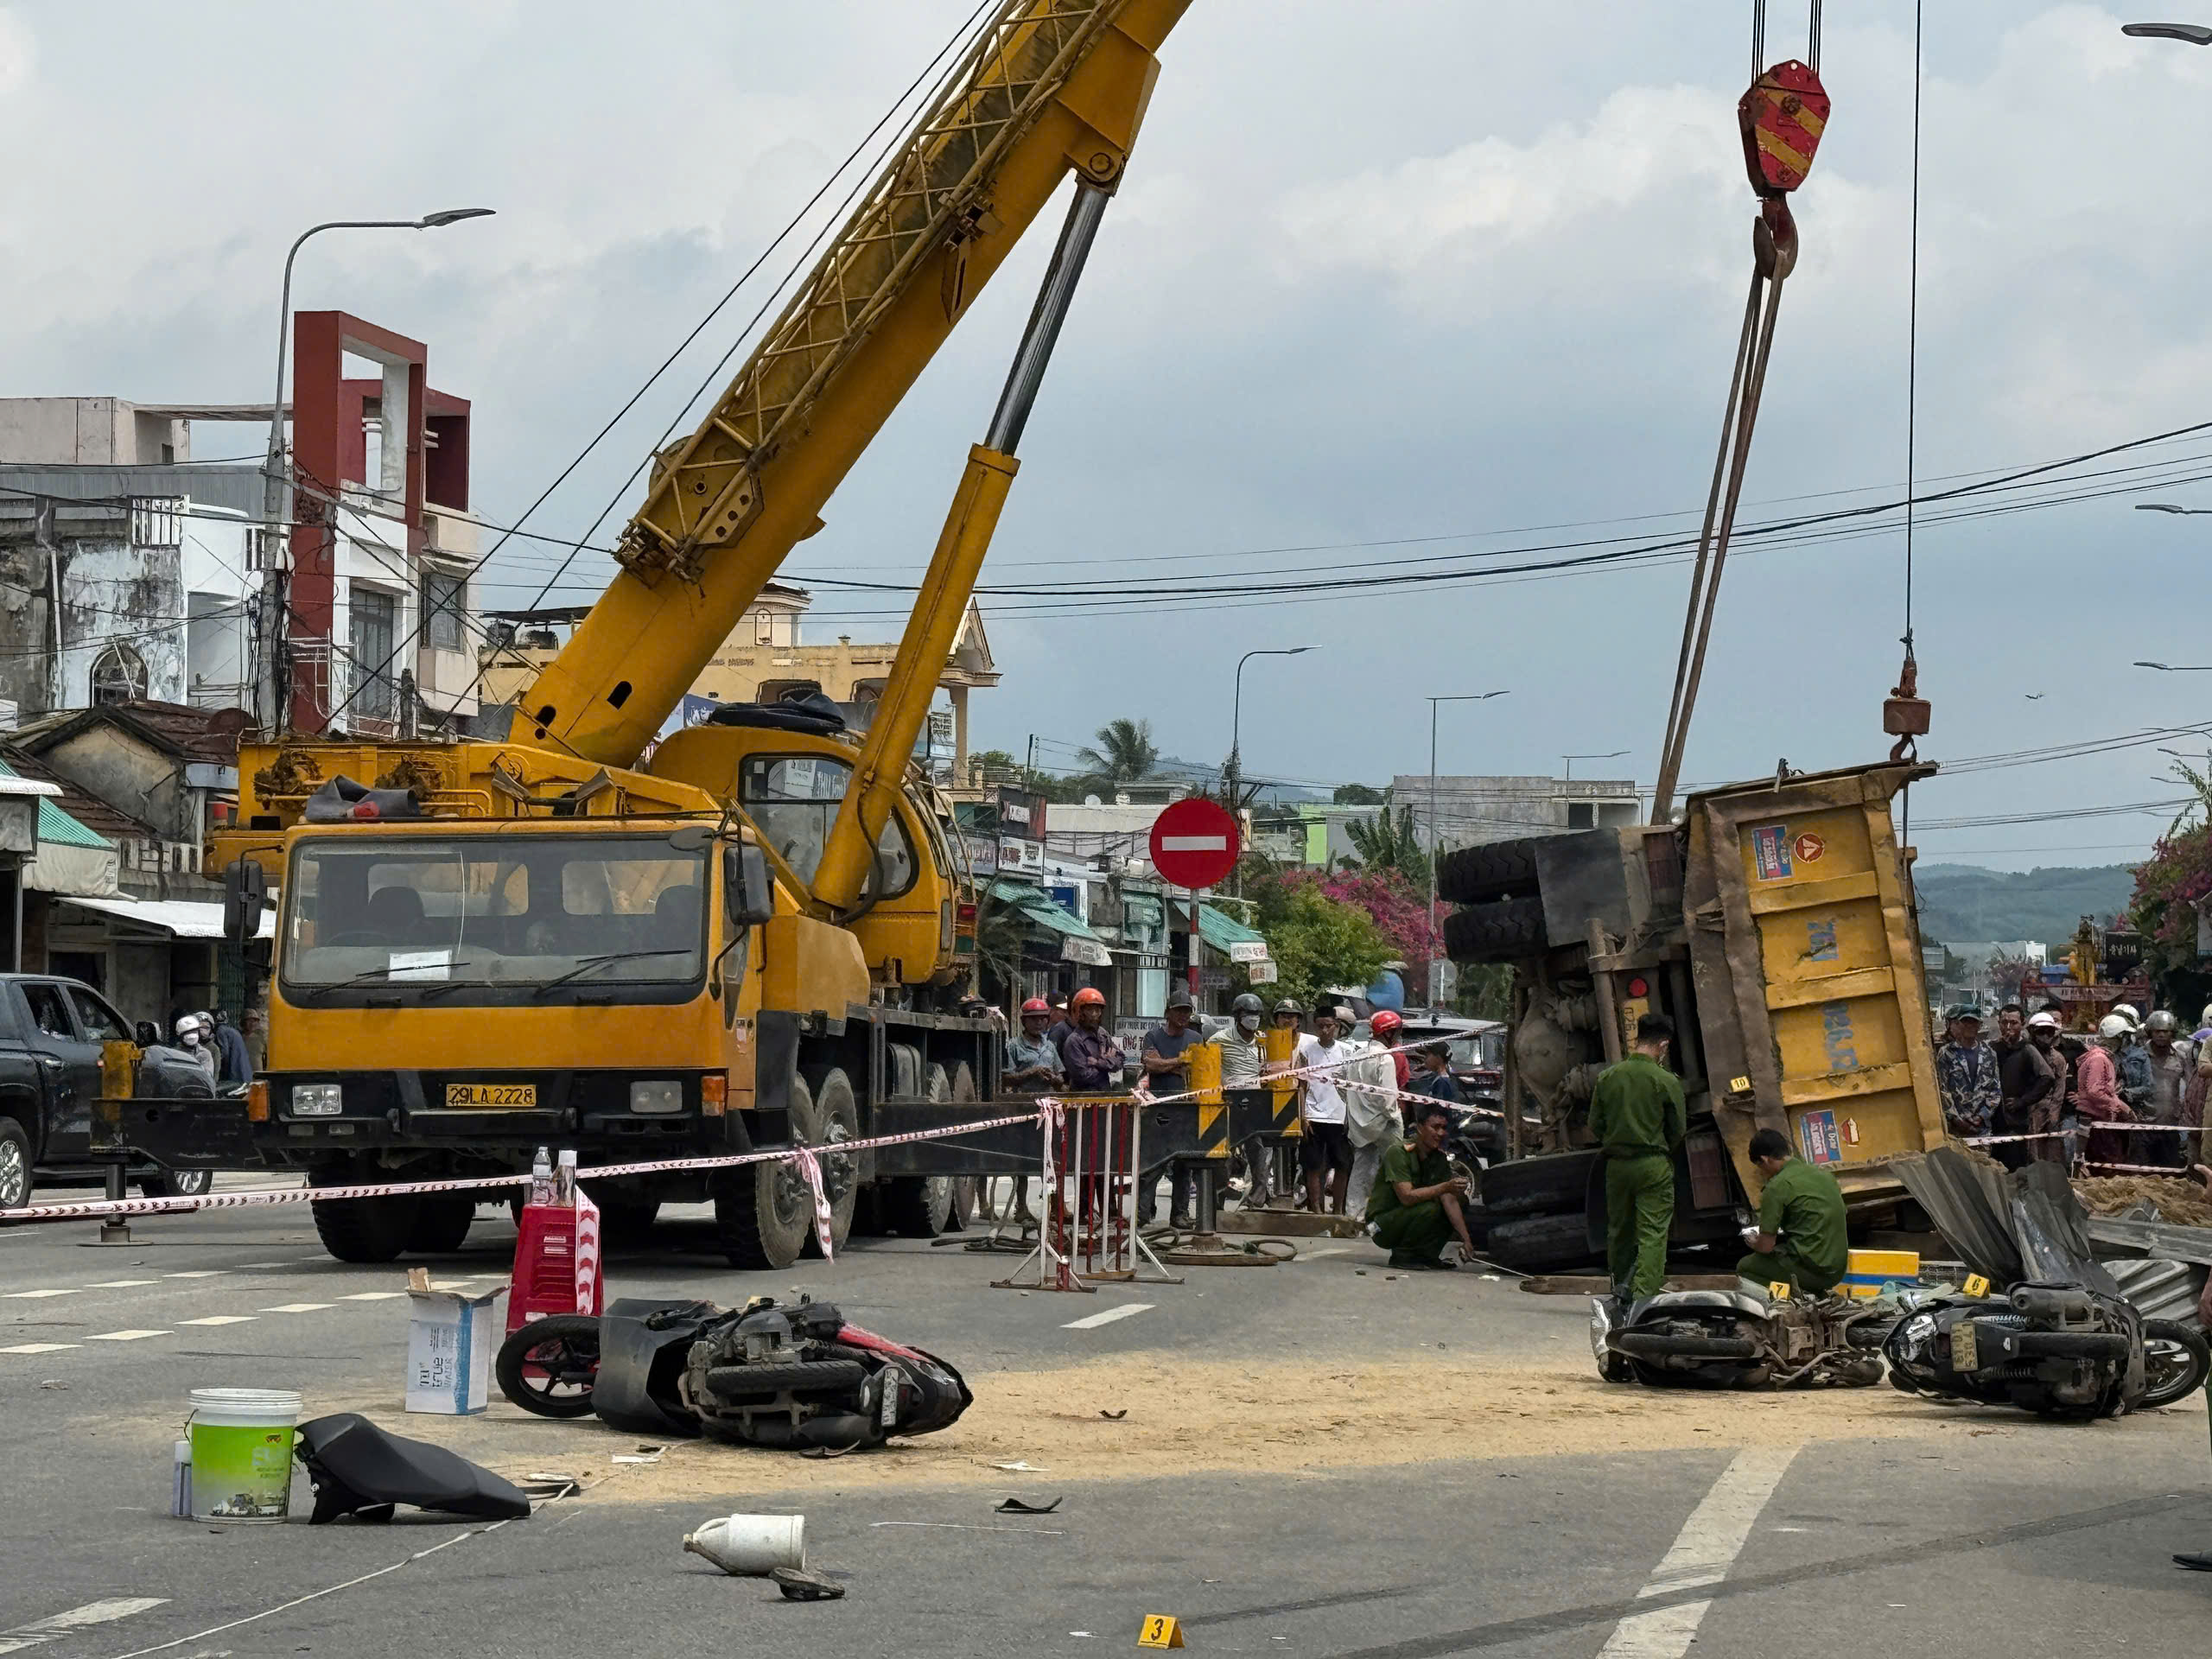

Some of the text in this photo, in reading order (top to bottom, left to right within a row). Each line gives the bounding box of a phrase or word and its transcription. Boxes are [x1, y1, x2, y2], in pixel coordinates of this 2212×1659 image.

[1735, 1079, 1745, 1088] 10
[1972, 1278, 1981, 1291] 6
[1776, 1284, 1784, 1300] 7
[1151, 1618, 1164, 1641] 3
